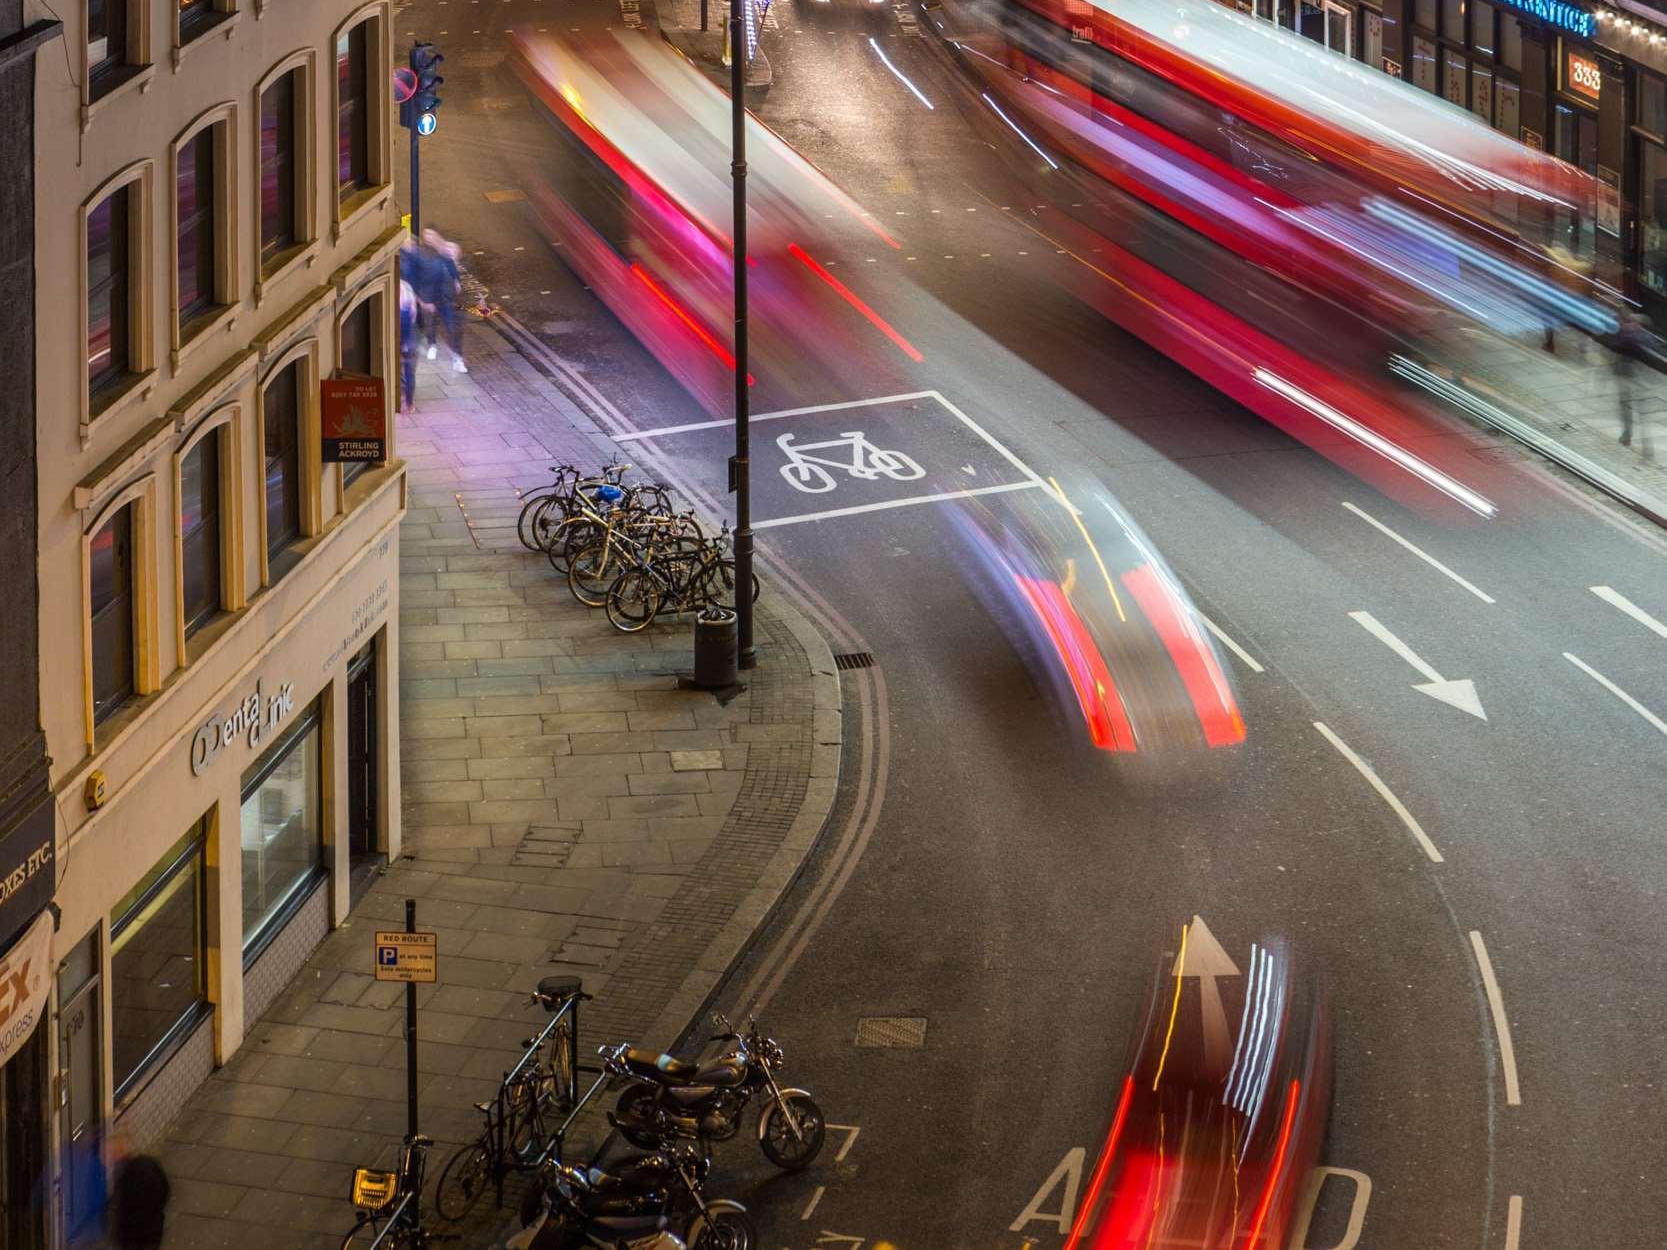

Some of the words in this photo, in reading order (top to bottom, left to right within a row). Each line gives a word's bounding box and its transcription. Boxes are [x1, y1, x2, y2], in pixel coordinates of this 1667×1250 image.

[1574, 61, 1601, 91] 333
[339, 441, 379, 450] STIRLING
[339, 450, 380, 458] ACKROYD
[383, 949, 396, 964] P
